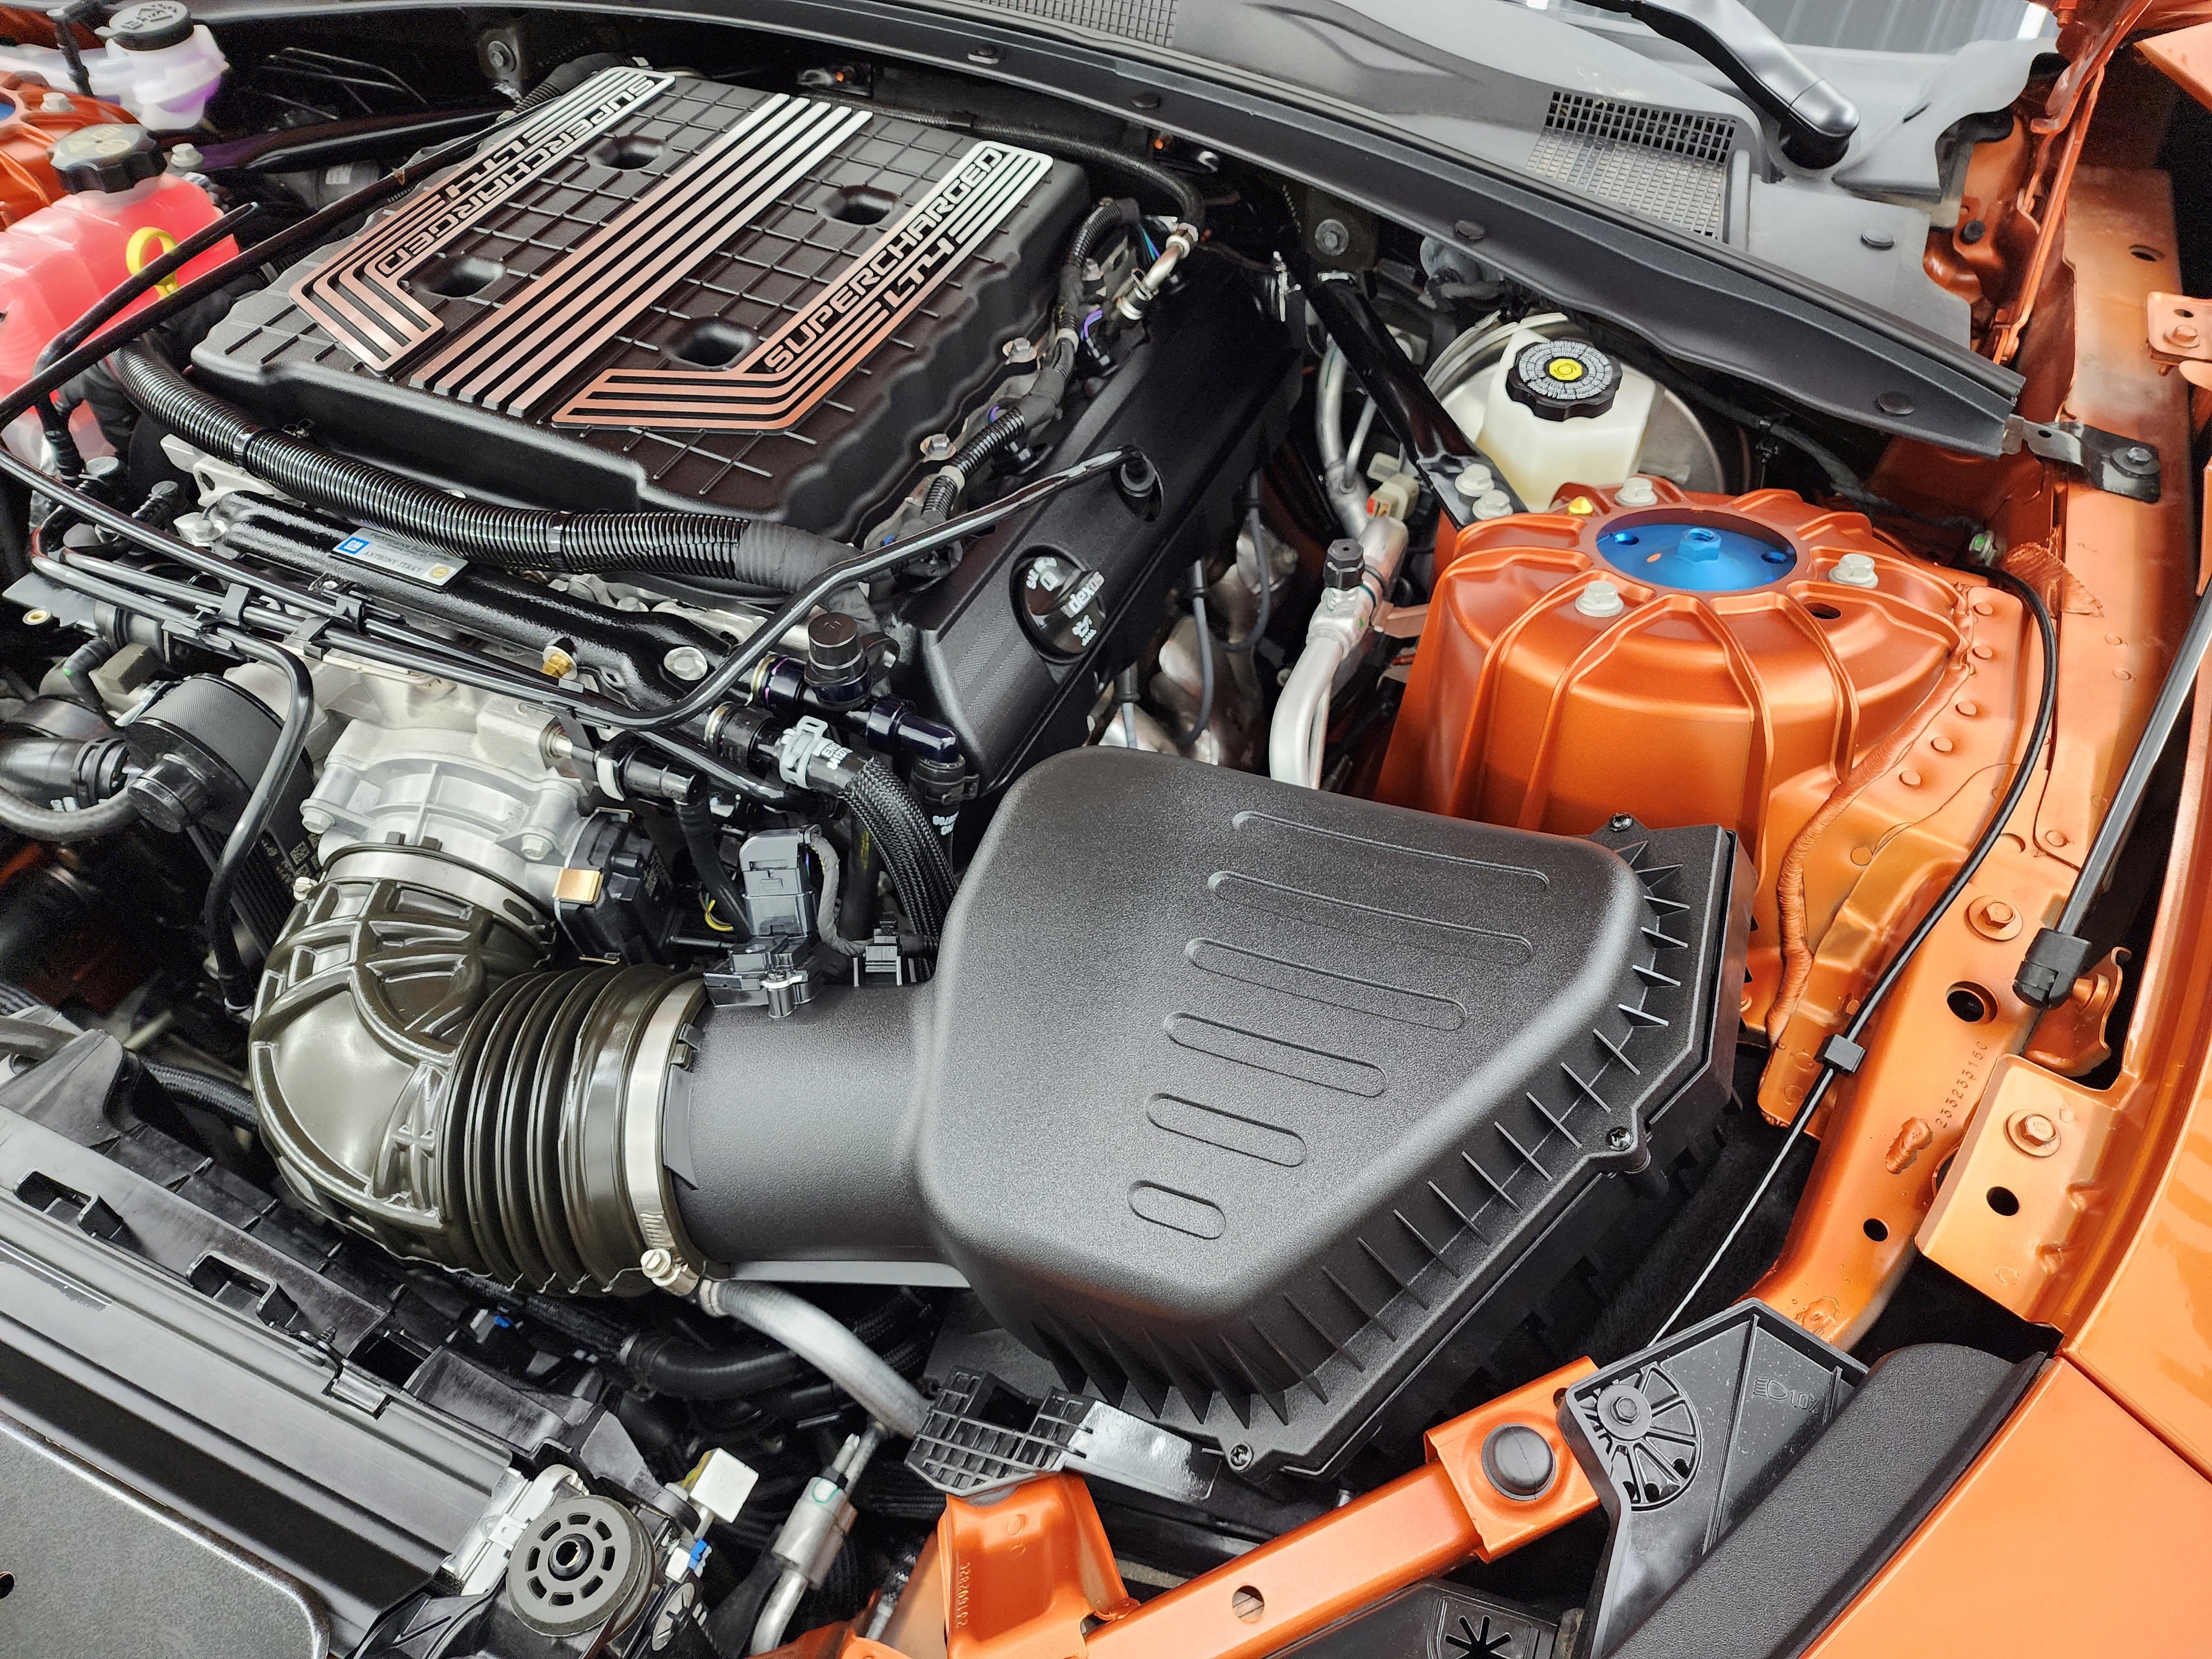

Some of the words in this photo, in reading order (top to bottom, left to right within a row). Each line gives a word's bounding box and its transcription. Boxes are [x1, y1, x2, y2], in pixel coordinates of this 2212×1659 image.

[377, 76, 655, 275] SUPERCHARGED
[446, 139, 525, 200] LT4
[764, 148, 1003, 372] SUPERCHARGED
[884, 237, 955, 307] LT4
[362, 550, 400, 565] ANTHONY
[397, 561, 424, 573] TERRY
[428, 551, 453, 561] Center
[1026, 568, 1039, 589] SAE
[1070, 571, 1105, 613] dexos
[1935, 1041, 1987, 1129] 23323315C
